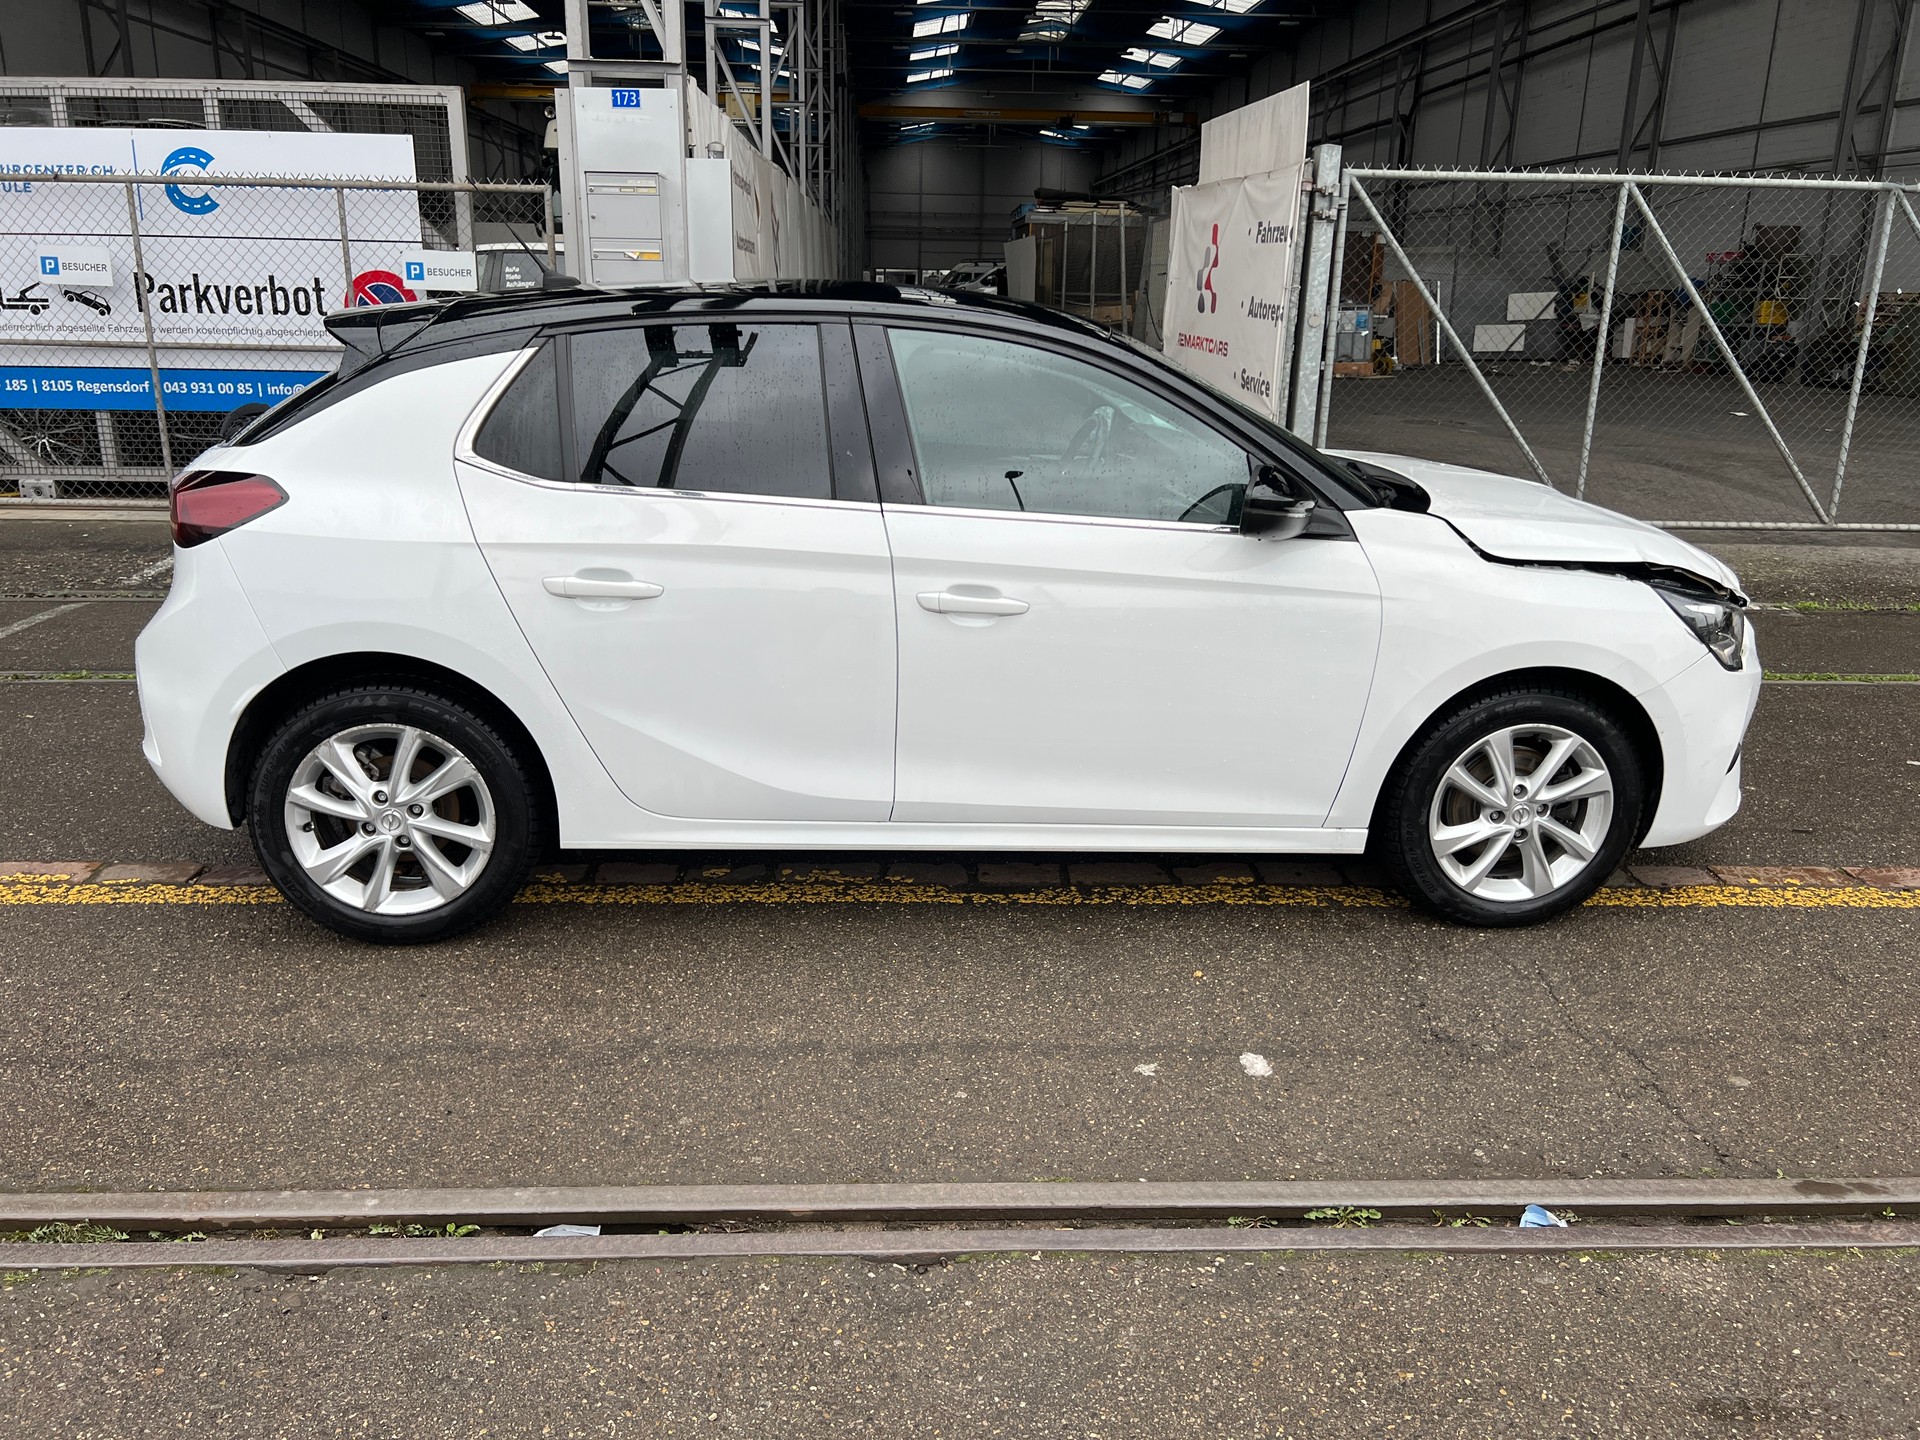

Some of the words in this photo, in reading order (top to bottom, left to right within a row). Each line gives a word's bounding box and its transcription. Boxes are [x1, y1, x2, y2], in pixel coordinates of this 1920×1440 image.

[615, 91, 637, 106] 173
[0, 164, 113, 175] URCENTERCH
[45, 259, 55, 273] P
[61, 262, 108, 272] BESUCHER
[410, 264, 420, 278] P
[426, 267, 472, 277] BESUCHER
[132, 271, 328, 317] Parkverbot
[0, 323, 54, 332] derrechtlich
[56, 323, 105, 333] abgestellte
[107, 323, 156, 334] Fahrzeue
[159, 326, 193, 334] werden
[196, 326, 263, 337] kostenpflichtig
[5, 379, 28, 391] 185
[41, 379, 73, 392] 8105
[77, 380, 150, 394] Regensdorf
[163, 381, 188, 394] 043
[190, 382, 215, 394] 931
[217, 382, 234, 395] 00
[237, 382, 253, 395] 85
[1240, 368, 1270, 398] Service
